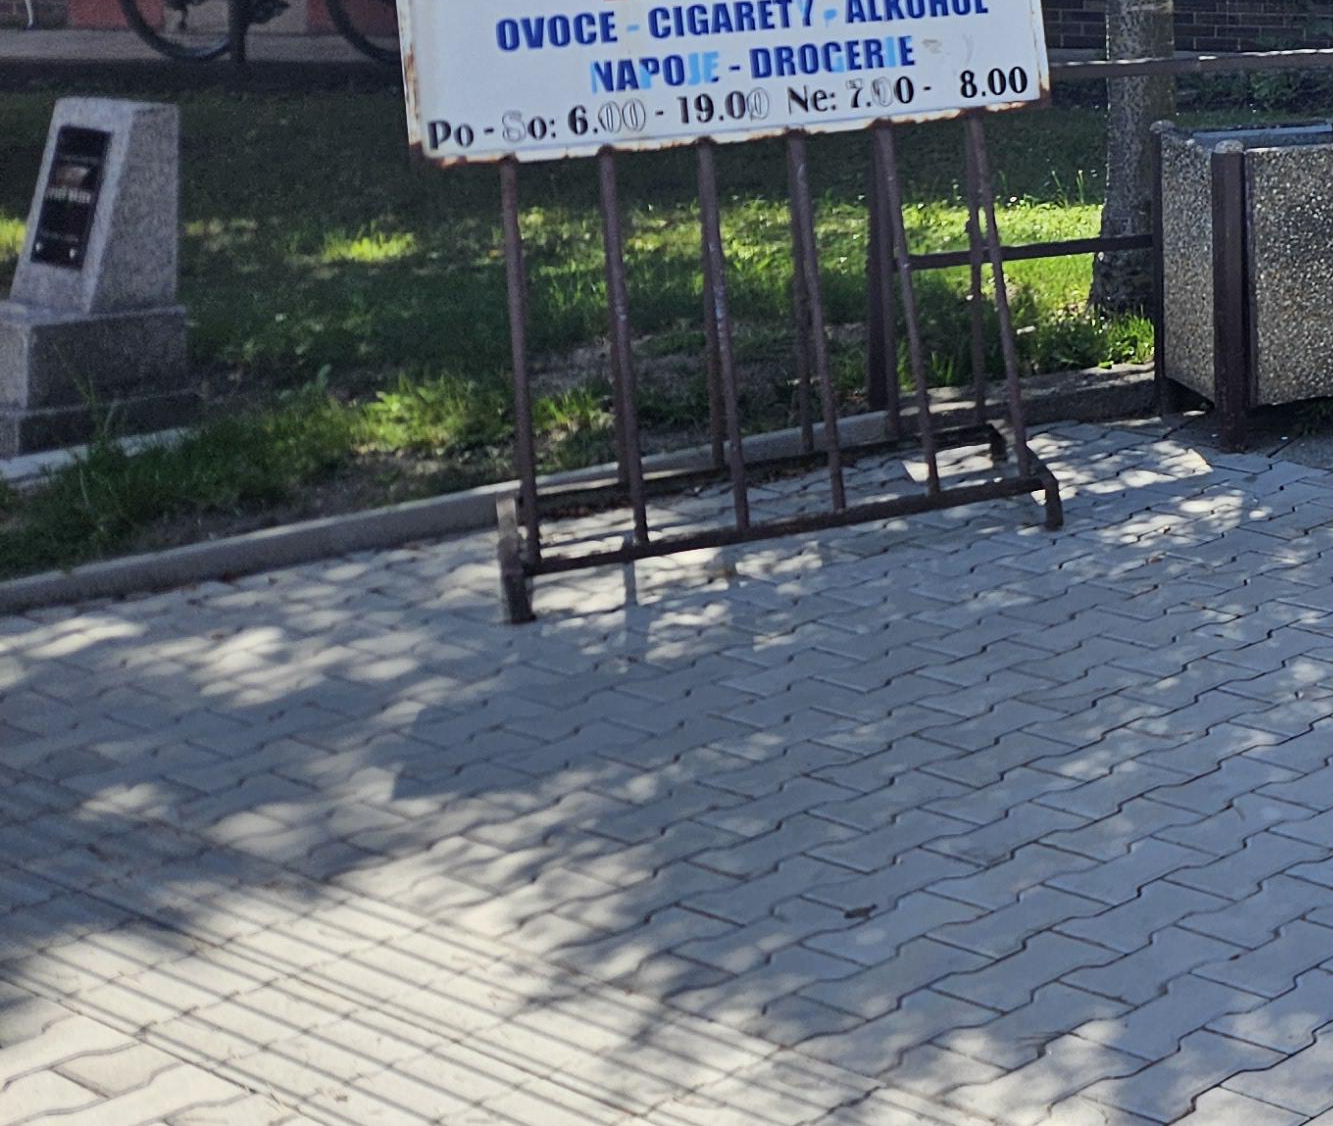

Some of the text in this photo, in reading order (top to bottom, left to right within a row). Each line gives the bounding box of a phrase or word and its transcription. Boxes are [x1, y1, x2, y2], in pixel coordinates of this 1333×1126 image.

[496, 11, 618, 51] OVOCE
[590, 52, 719, 94] NAPOJE
[750, 36, 916, 79] DROGERIE
[427, 120, 475, 151] Po
[567, 98, 646, 139] 6.00
[677, 87, 770, 124] 19.00
[787, 84, 837, 115] Ne:
[846, 75, 914, 109] 7.00
[960, 66, 1028, 99] 8.00
